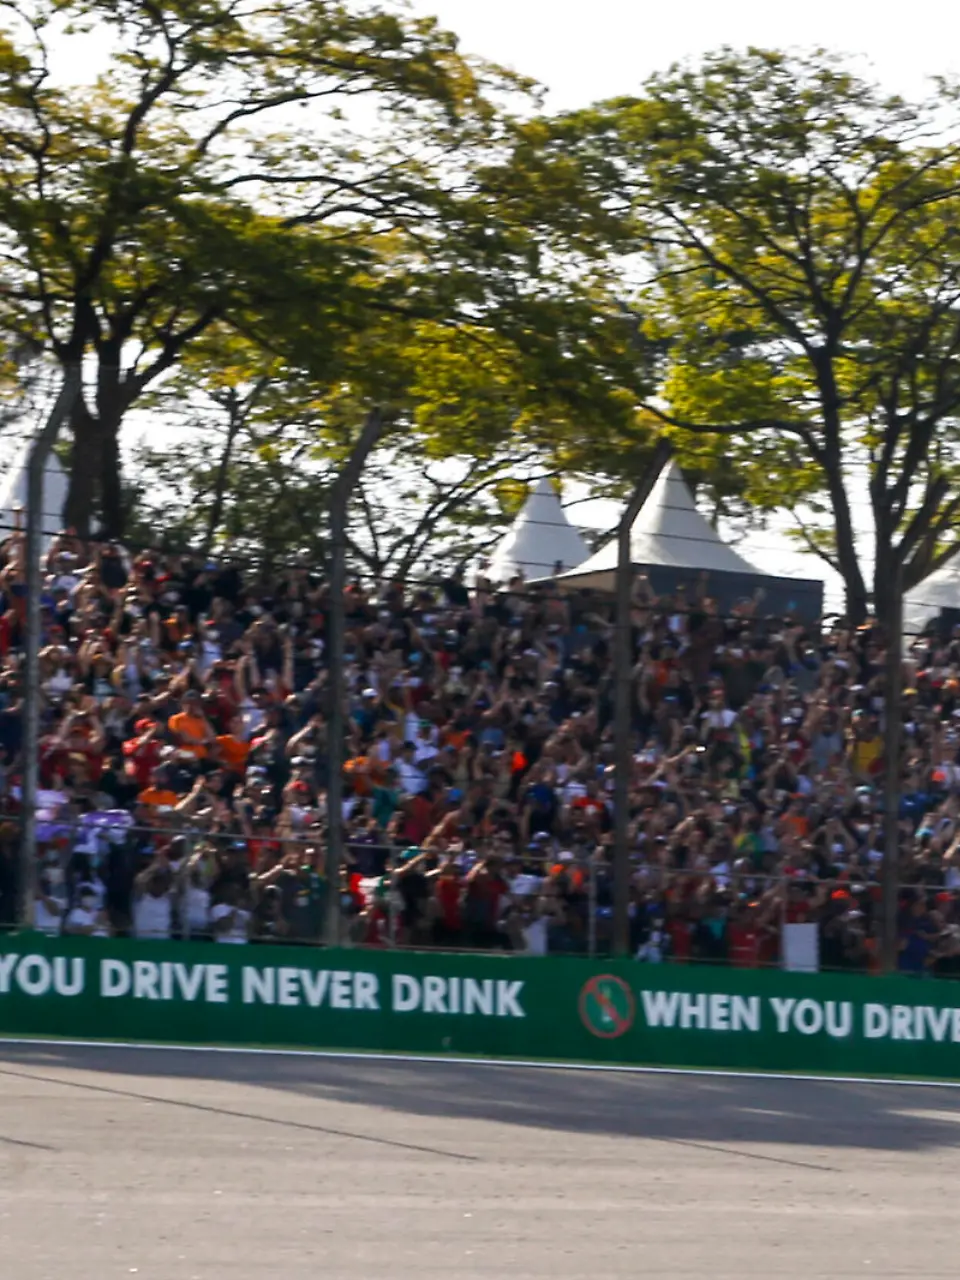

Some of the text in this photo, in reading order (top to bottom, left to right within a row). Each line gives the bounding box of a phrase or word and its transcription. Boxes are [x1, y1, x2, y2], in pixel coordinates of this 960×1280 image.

[0, 954, 525, 1017] YOU DRIVE NEVER DRINK
[642, 990, 759, 1031] WHEN
[770, 997, 851, 1037] YOU
